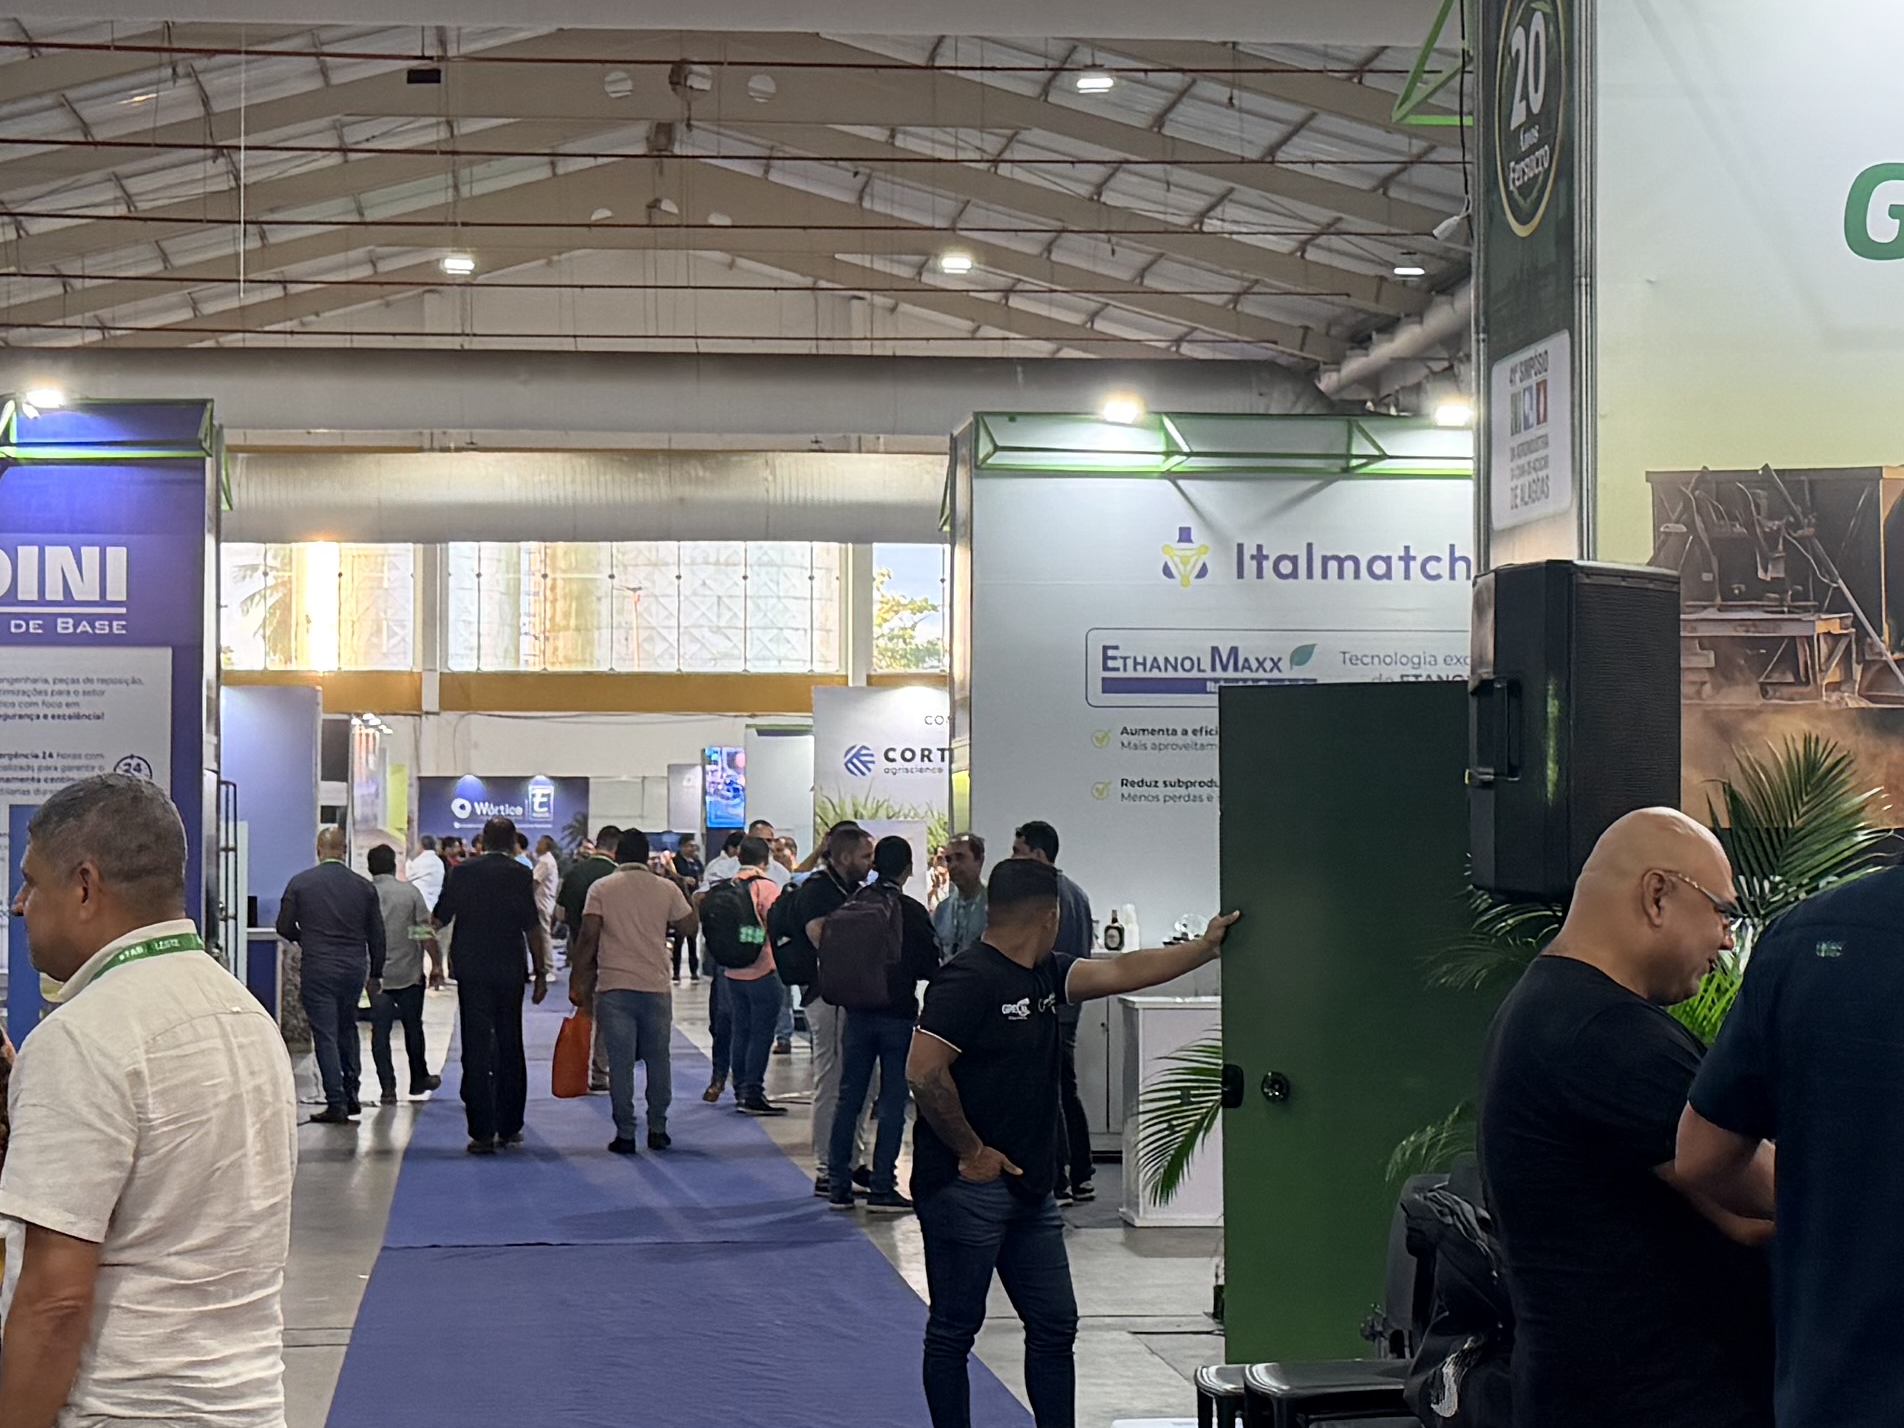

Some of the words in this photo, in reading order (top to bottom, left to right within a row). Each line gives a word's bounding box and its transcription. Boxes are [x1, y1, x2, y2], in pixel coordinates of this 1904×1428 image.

[1510, 11, 1546, 131] 20
[1236, 542, 1472, 581] Italmatch
[1339, 651, 1438, 670] Tecnologia
[1120, 726, 1178, 736] Aumenta
[1181, 728, 1189, 736] a
[1120, 740, 1148, 750] Mais
[1120, 778, 1159, 788] Reduz
